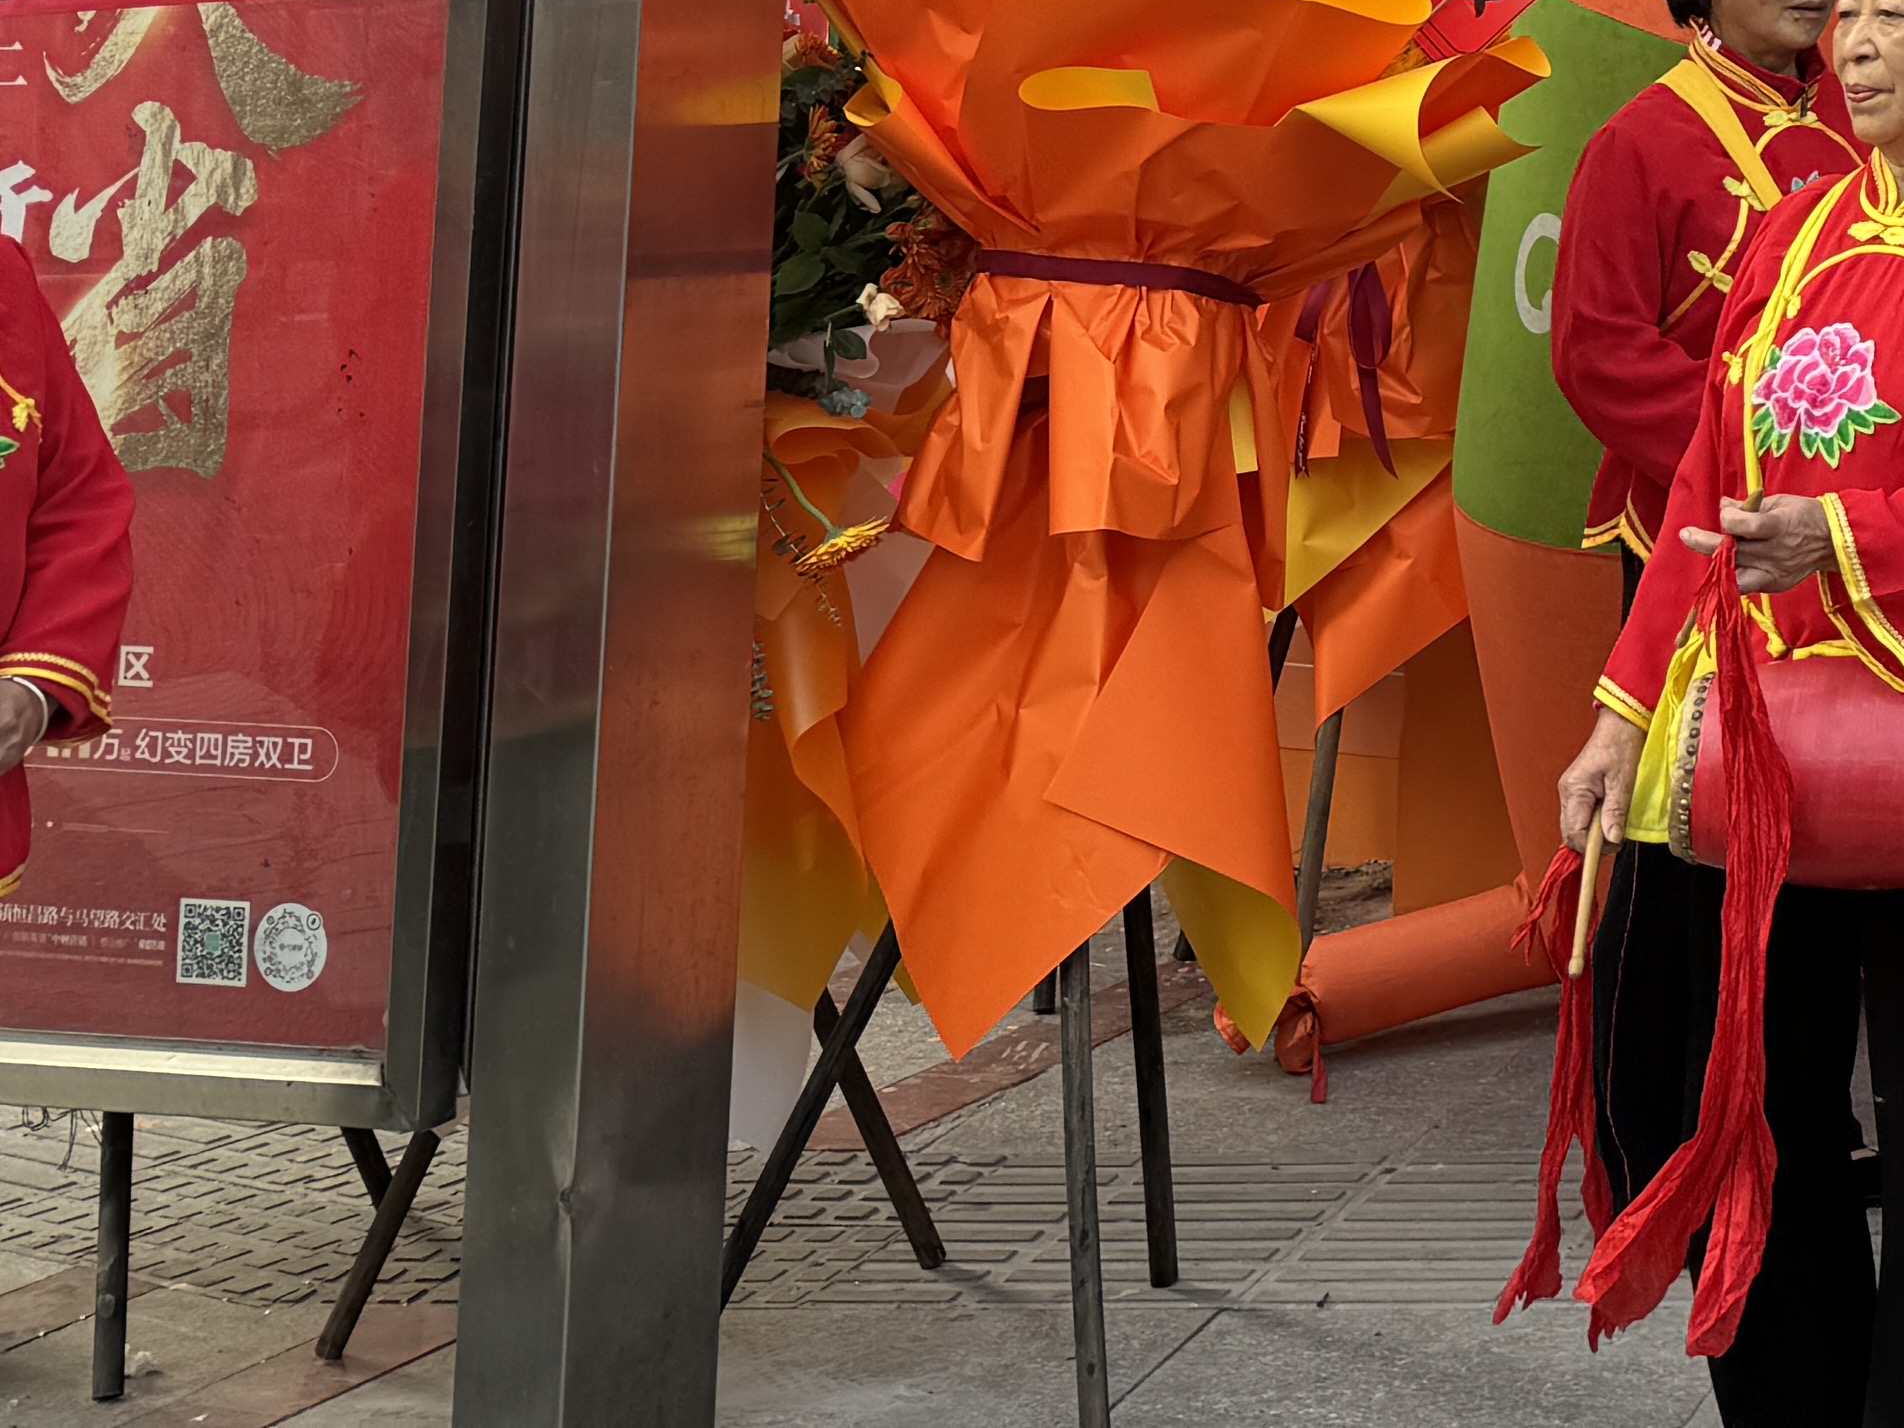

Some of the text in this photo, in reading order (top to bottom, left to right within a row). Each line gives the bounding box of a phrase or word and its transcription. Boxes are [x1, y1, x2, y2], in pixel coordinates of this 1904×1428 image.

[135, 728, 313, 771] 幻变四房双卫
